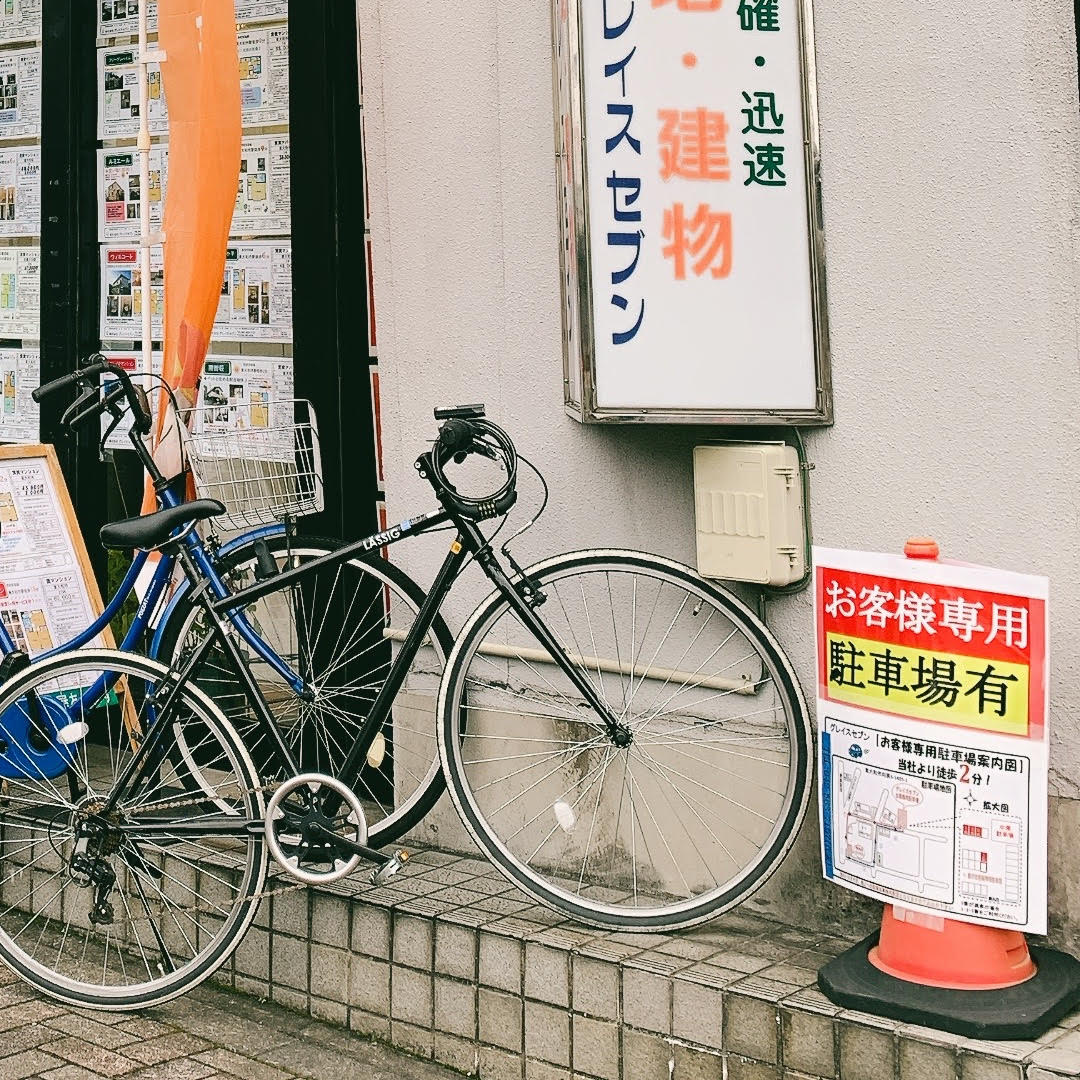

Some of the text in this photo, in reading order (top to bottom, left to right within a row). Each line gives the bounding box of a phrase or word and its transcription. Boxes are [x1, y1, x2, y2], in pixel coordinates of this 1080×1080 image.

[825, 579, 1029, 649] お客様専用
[829, 640, 1018, 718] 駐車場有
[830, 723, 870, 741] グレイスセブン
